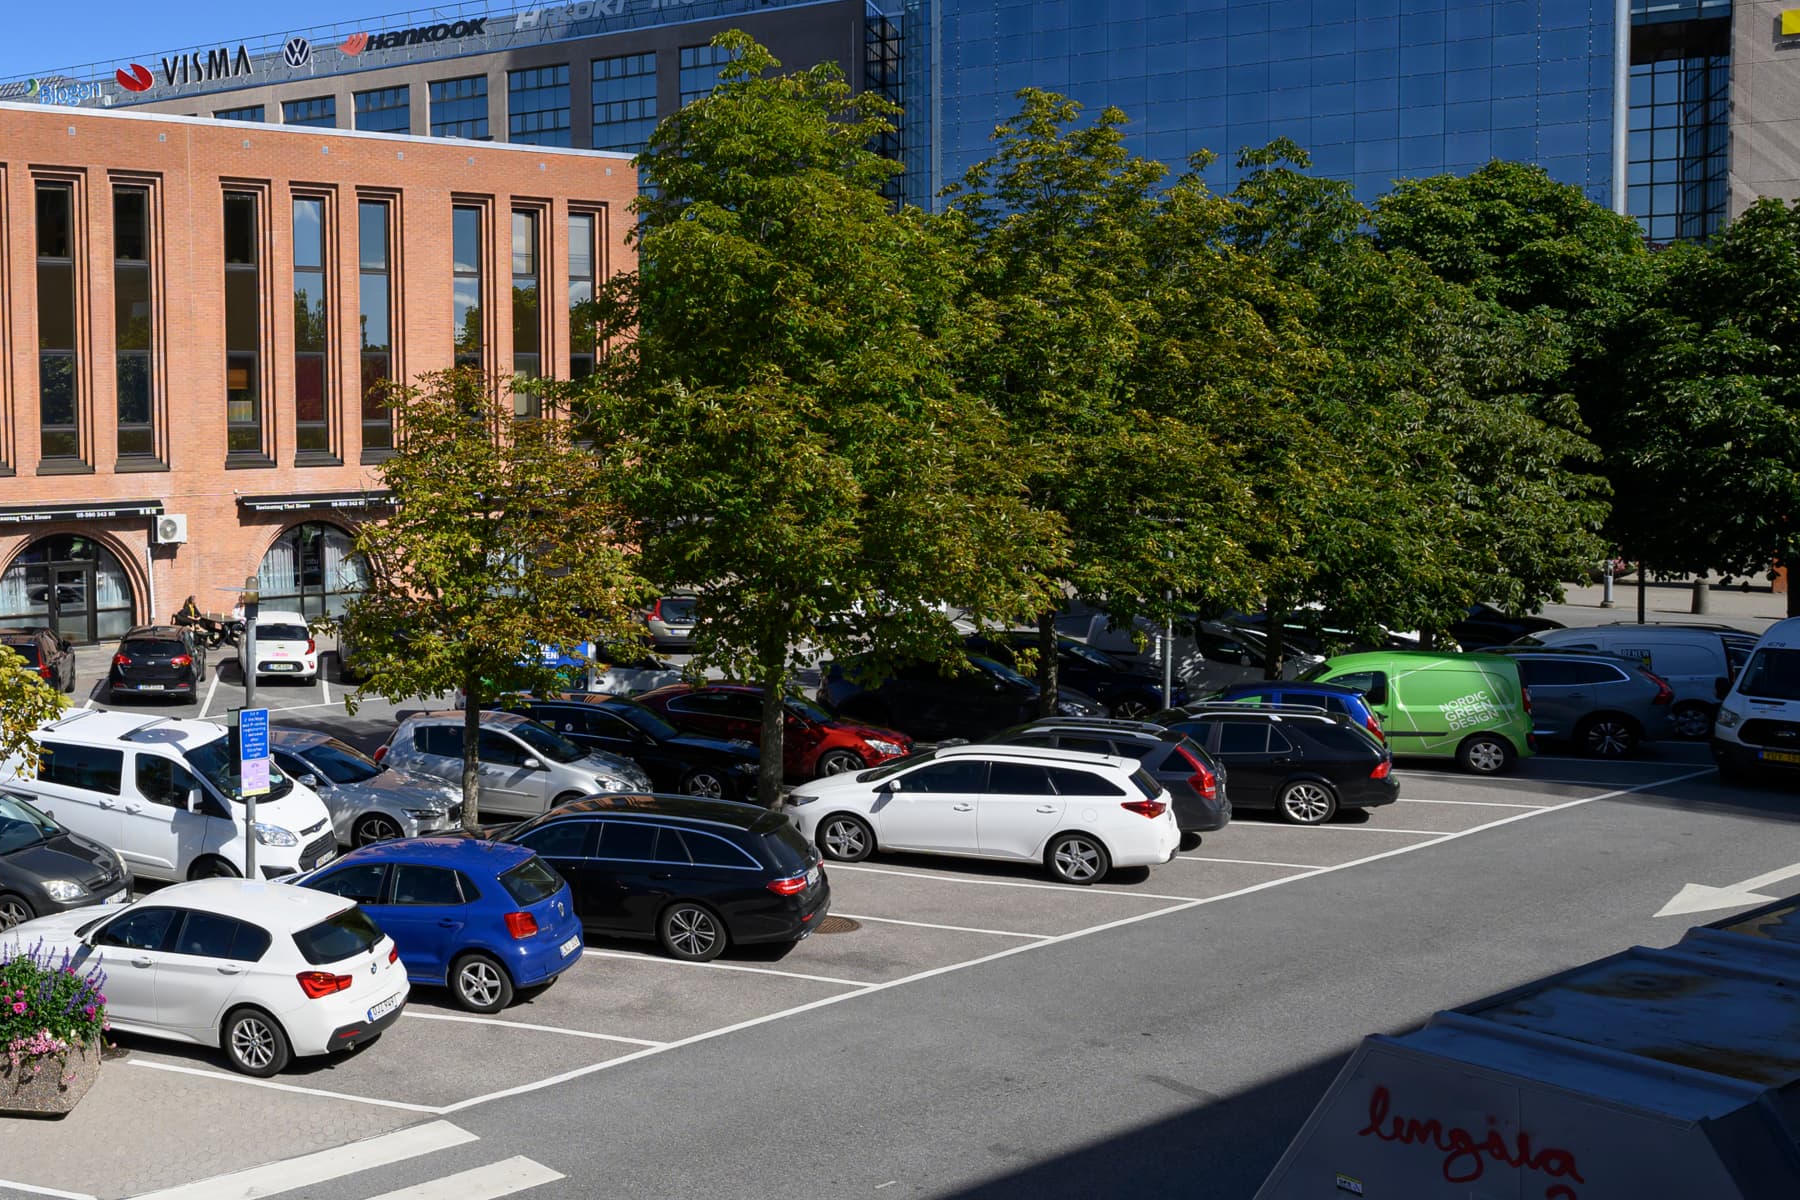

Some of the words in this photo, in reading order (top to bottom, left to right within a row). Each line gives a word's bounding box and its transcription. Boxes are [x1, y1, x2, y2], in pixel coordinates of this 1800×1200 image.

[161, 44, 254, 87] VISMA
[39, 82, 102, 106] Biogen
[1438, 690, 1488, 712] NORDIC
[1445, 699, 1495, 721] GREEN
[1449, 710, 1499, 731] DESIGN
